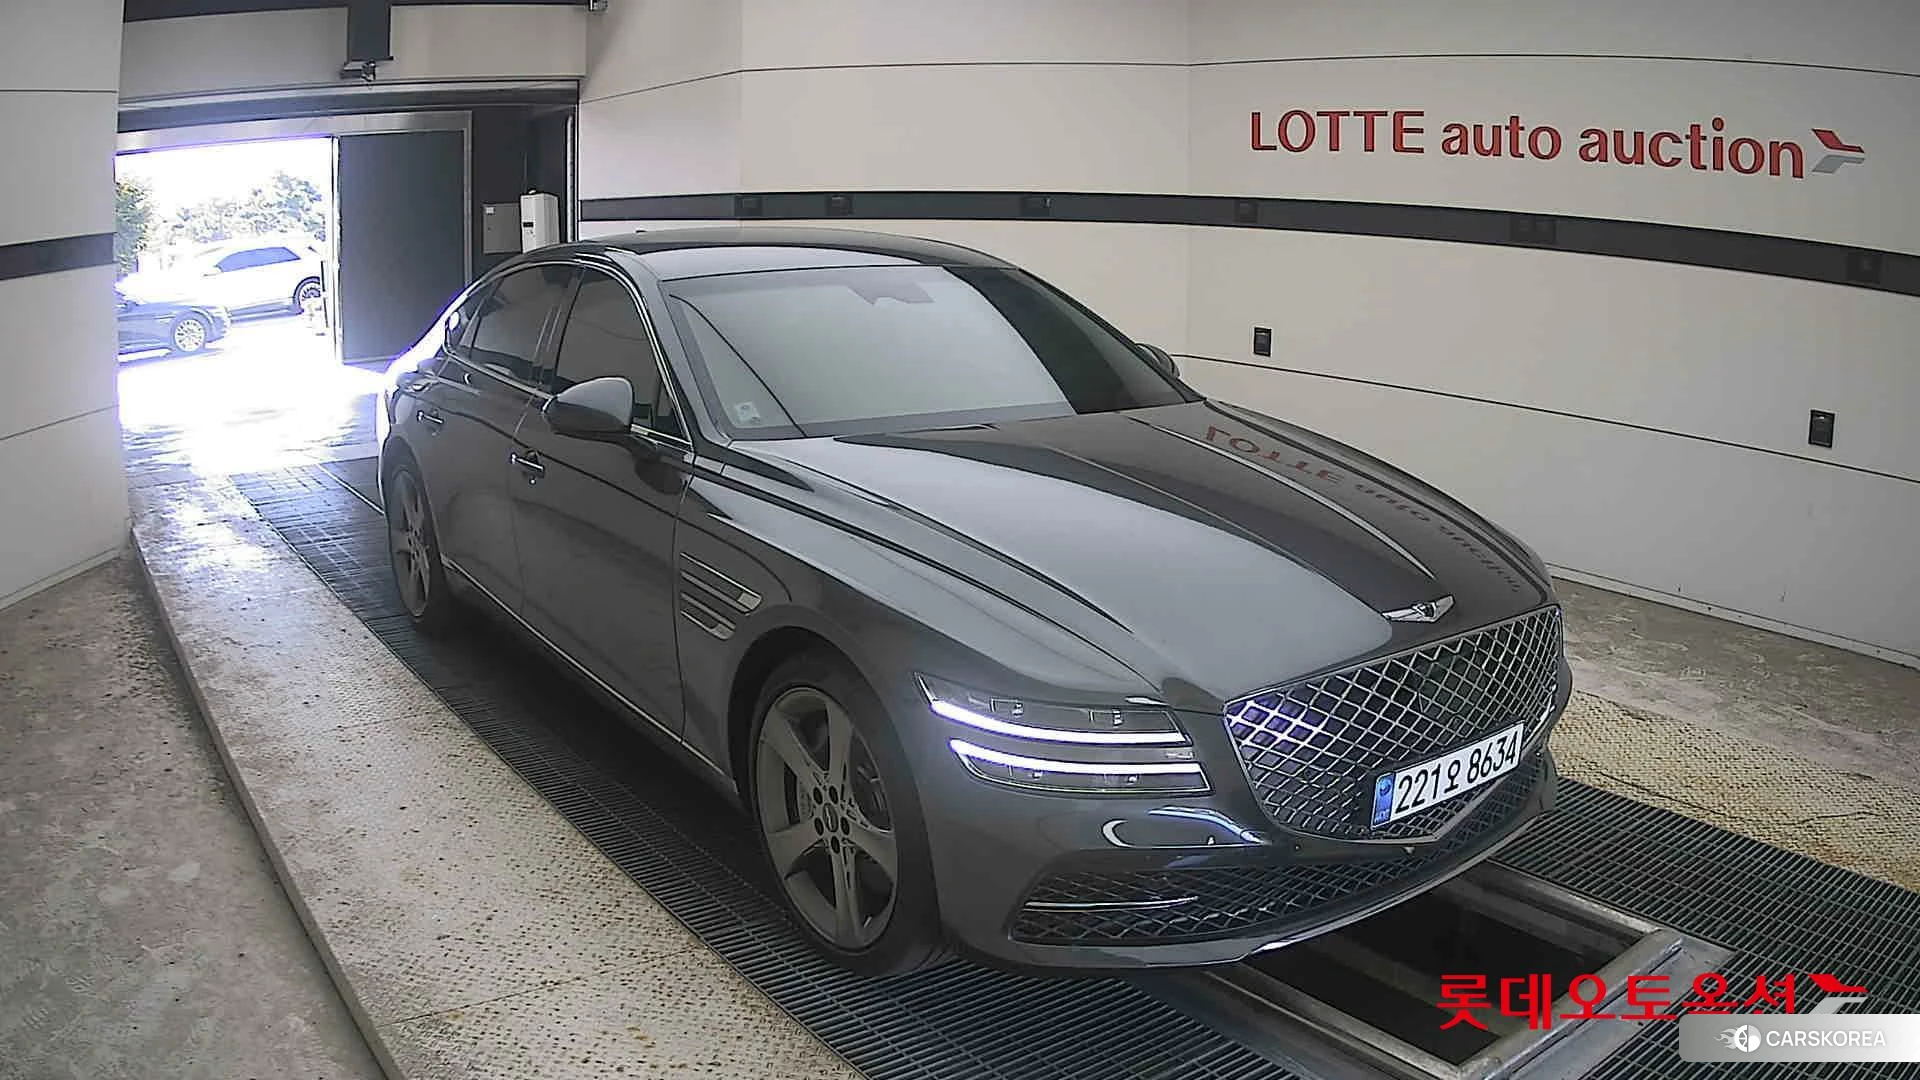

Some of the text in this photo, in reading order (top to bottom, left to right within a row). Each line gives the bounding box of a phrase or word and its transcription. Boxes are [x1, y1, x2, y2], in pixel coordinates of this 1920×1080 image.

[1251, 110, 1804, 179] LOTTE auto auction
[1394, 730, 1518, 815] 221오 8634
